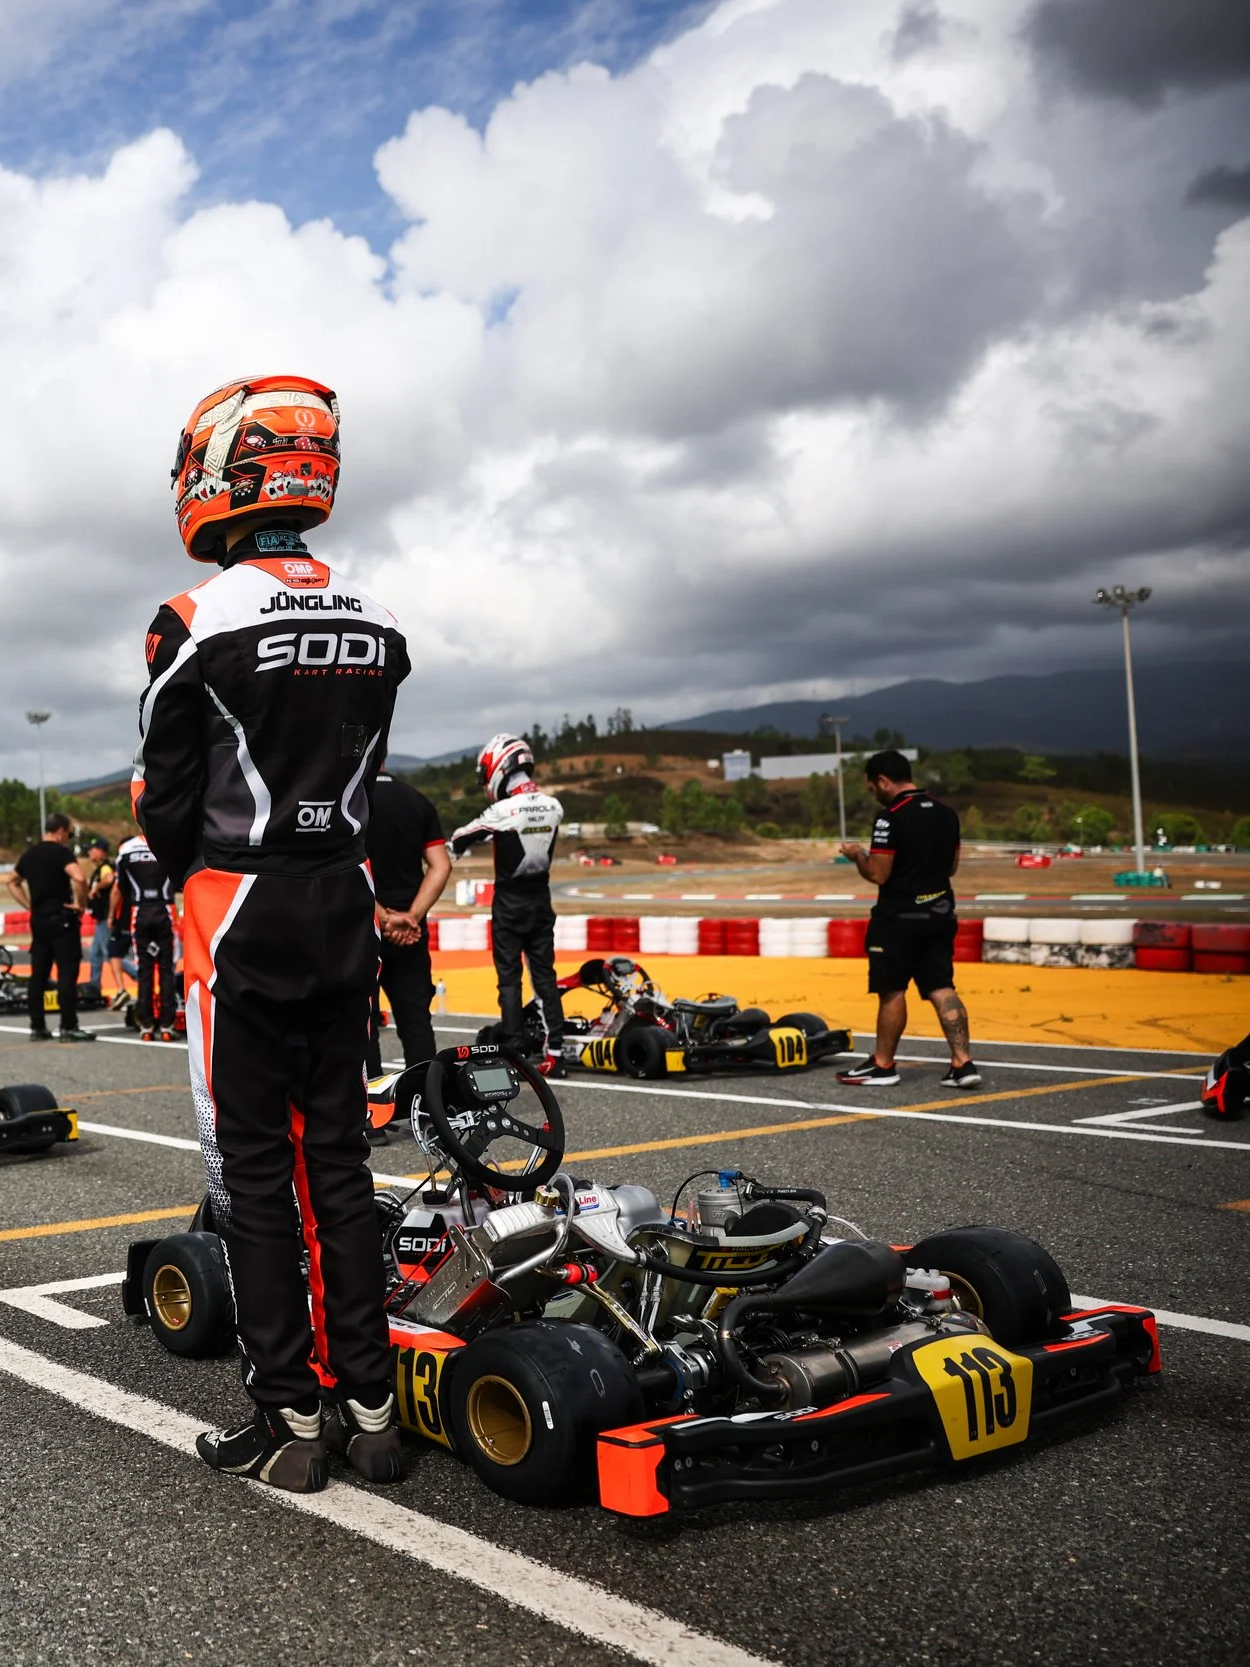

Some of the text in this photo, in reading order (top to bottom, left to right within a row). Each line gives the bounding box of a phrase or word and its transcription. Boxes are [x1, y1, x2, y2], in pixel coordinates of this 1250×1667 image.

[258, 535, 278, 546] FIA
[283, 563, 315, 574] OMP
[259, 591, 363, 615] JÜNGLING
[254, 632, 387, 673] SODI
[293, 668, 384, 677] KART RACING
[296, 805, 333, 829] OM
[129, 852, 157, 863] SO
[470, 1044, 500, 1055] SODI
[590, 1039, 613, 1069] 104
[779, 1034, 804, 1064] 104
[398, 1237, 447, 1253] SODI
[943, 1347, 1017, 1442] 113
[773, 1405, 818, 1421] SODI
